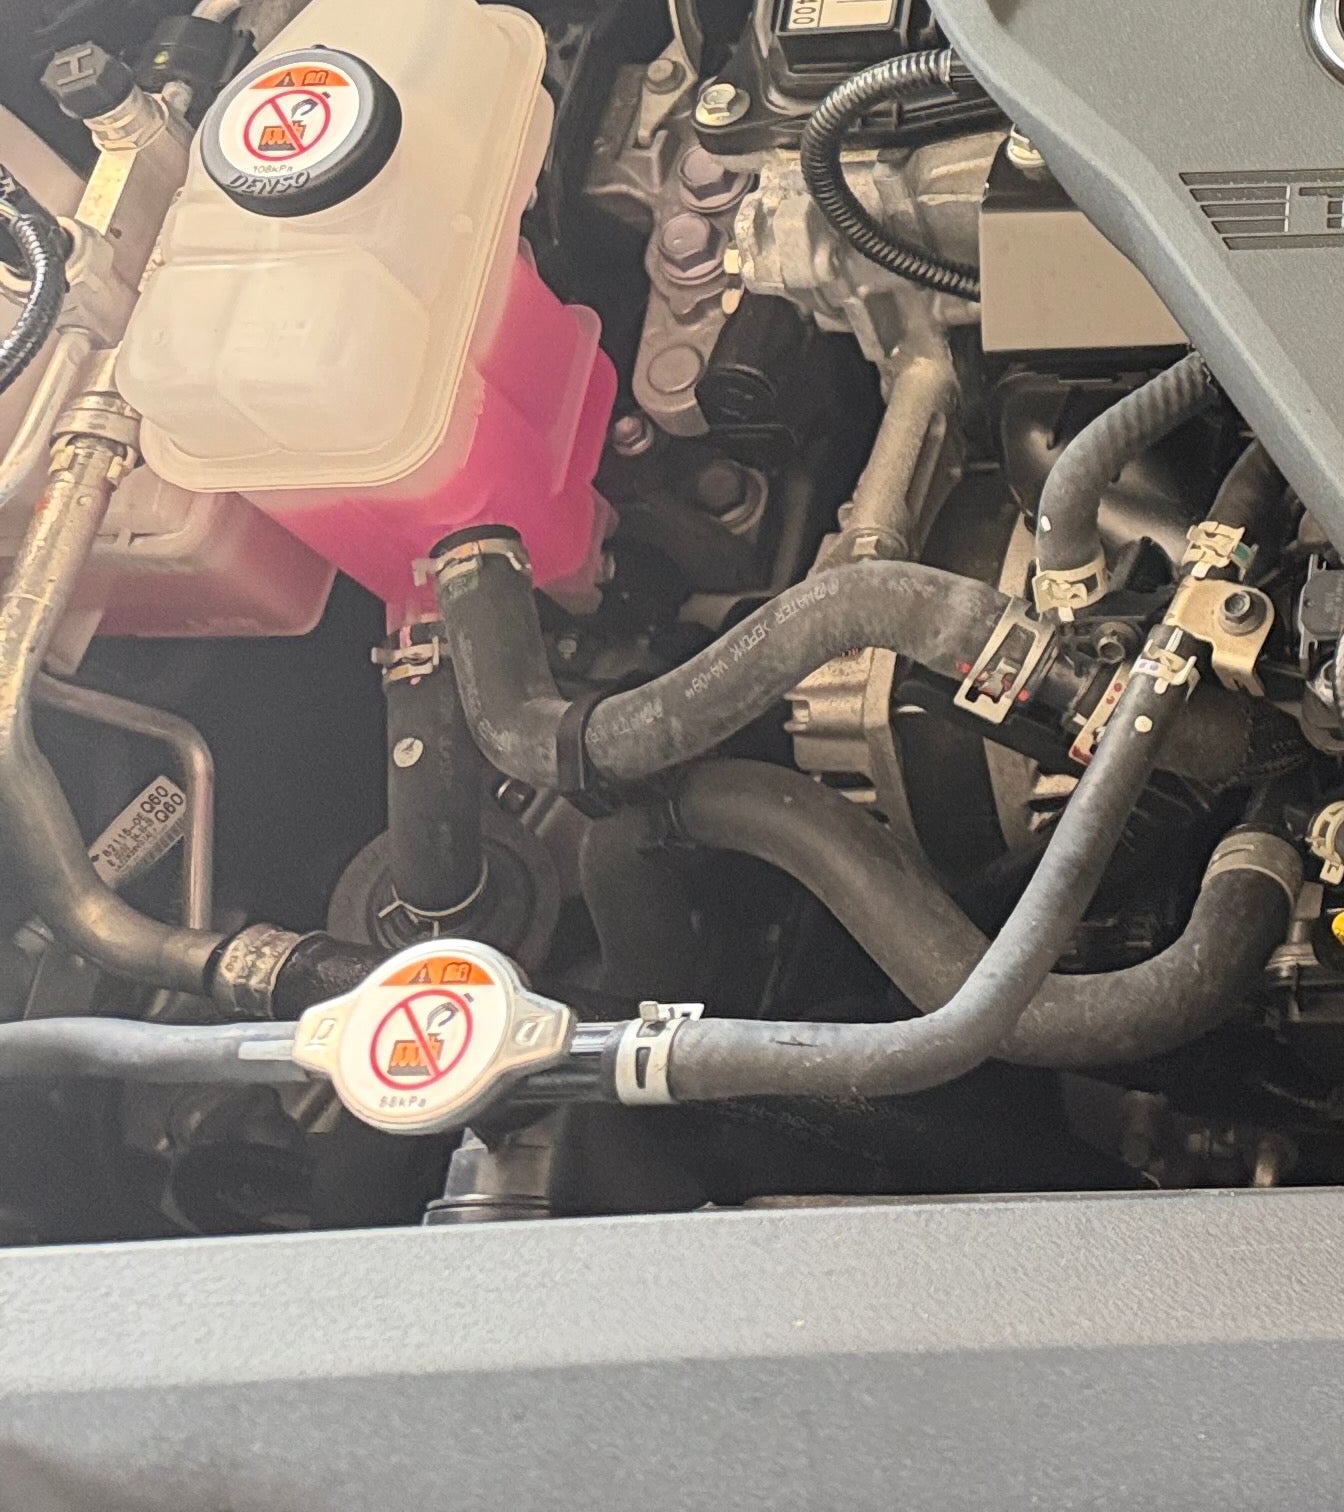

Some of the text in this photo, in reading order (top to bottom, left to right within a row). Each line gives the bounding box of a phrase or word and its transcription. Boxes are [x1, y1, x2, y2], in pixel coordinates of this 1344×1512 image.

[55, 48, 95, 86] H
[226, 169, 310, 195] DENSO
[140, 786, 169, 813] Q60
[155, 793, 183, 823] Q60
